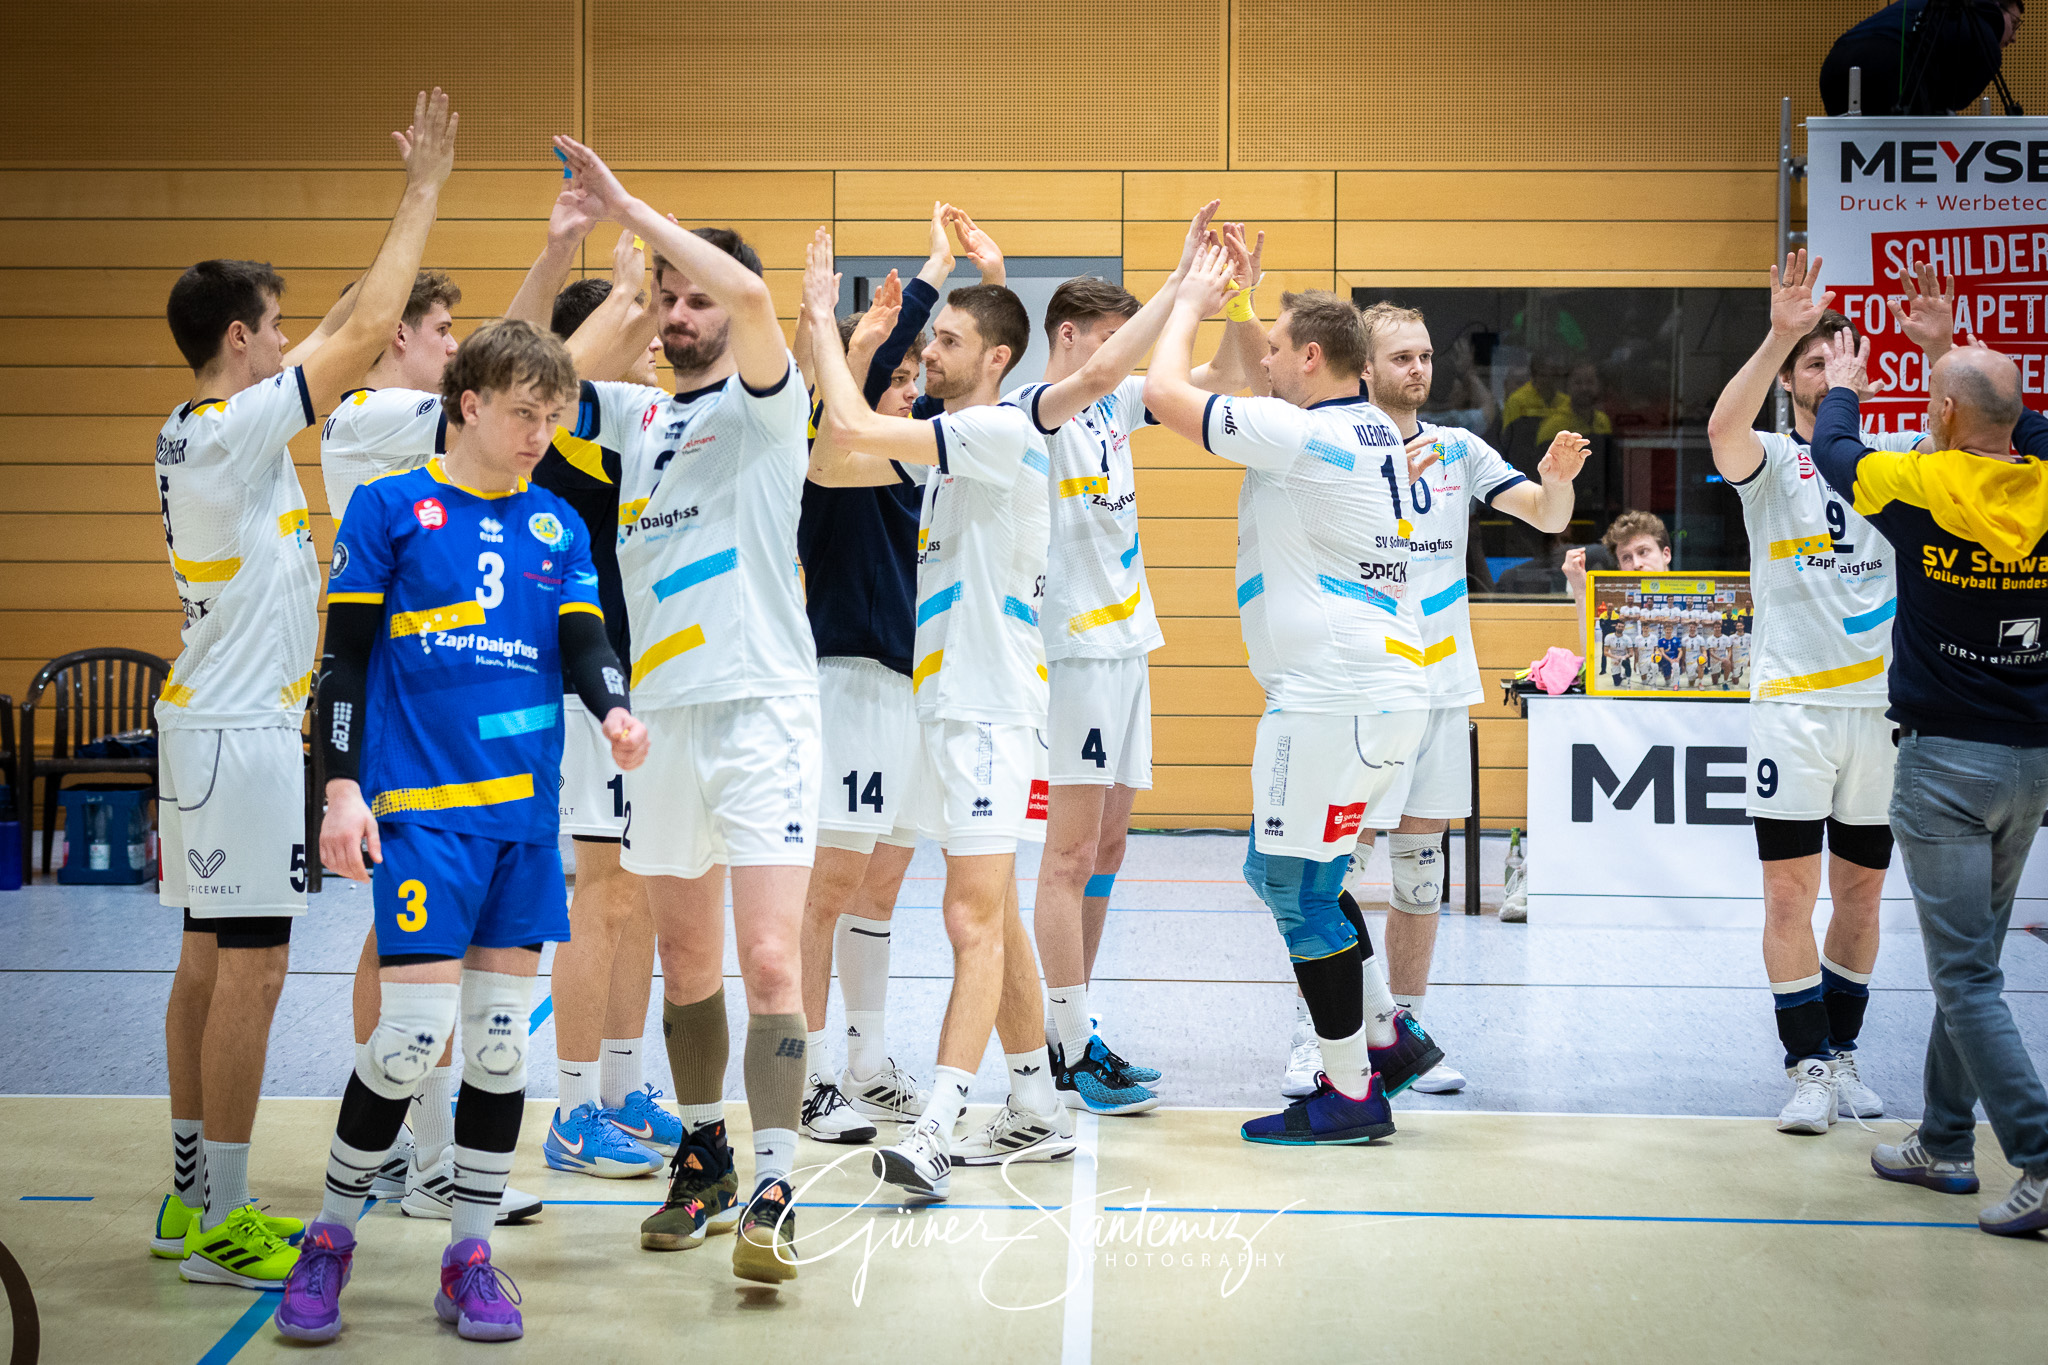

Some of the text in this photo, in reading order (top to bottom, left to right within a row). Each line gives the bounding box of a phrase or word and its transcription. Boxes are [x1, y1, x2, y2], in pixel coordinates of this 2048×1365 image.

[1840, 195, 1907, 211] Druck
[1916, 198, 1928, 209] +
[1884, 233, 2048, 280] SCHILDER
[1844, 294, 2048, 335] FOTAPET
[1826, 500, 1846, 541] 9
[1389, 536, 1411, 549] Schwa
[1409, 538, 1453, 553] Daigfuss
[1922, 544, 1959, 569] SV
[475, 551, 505, 610] 3
[1807, 555, 1883, 576] Zapf aigfuss
[1924, 565, 2048, 590] Volleyball Bundes
[435, 630, 539, 660] Zapf Daigfuss
[1081, 728, 1107, 769] 4
[843, 770, 884, 813] 14
[1756, 758, 1779, 799] 9
[290, 844, 306, 893] 5
[188, 885, 242, 895] FFICEWELT
[396, 879, 430, 933] 3
